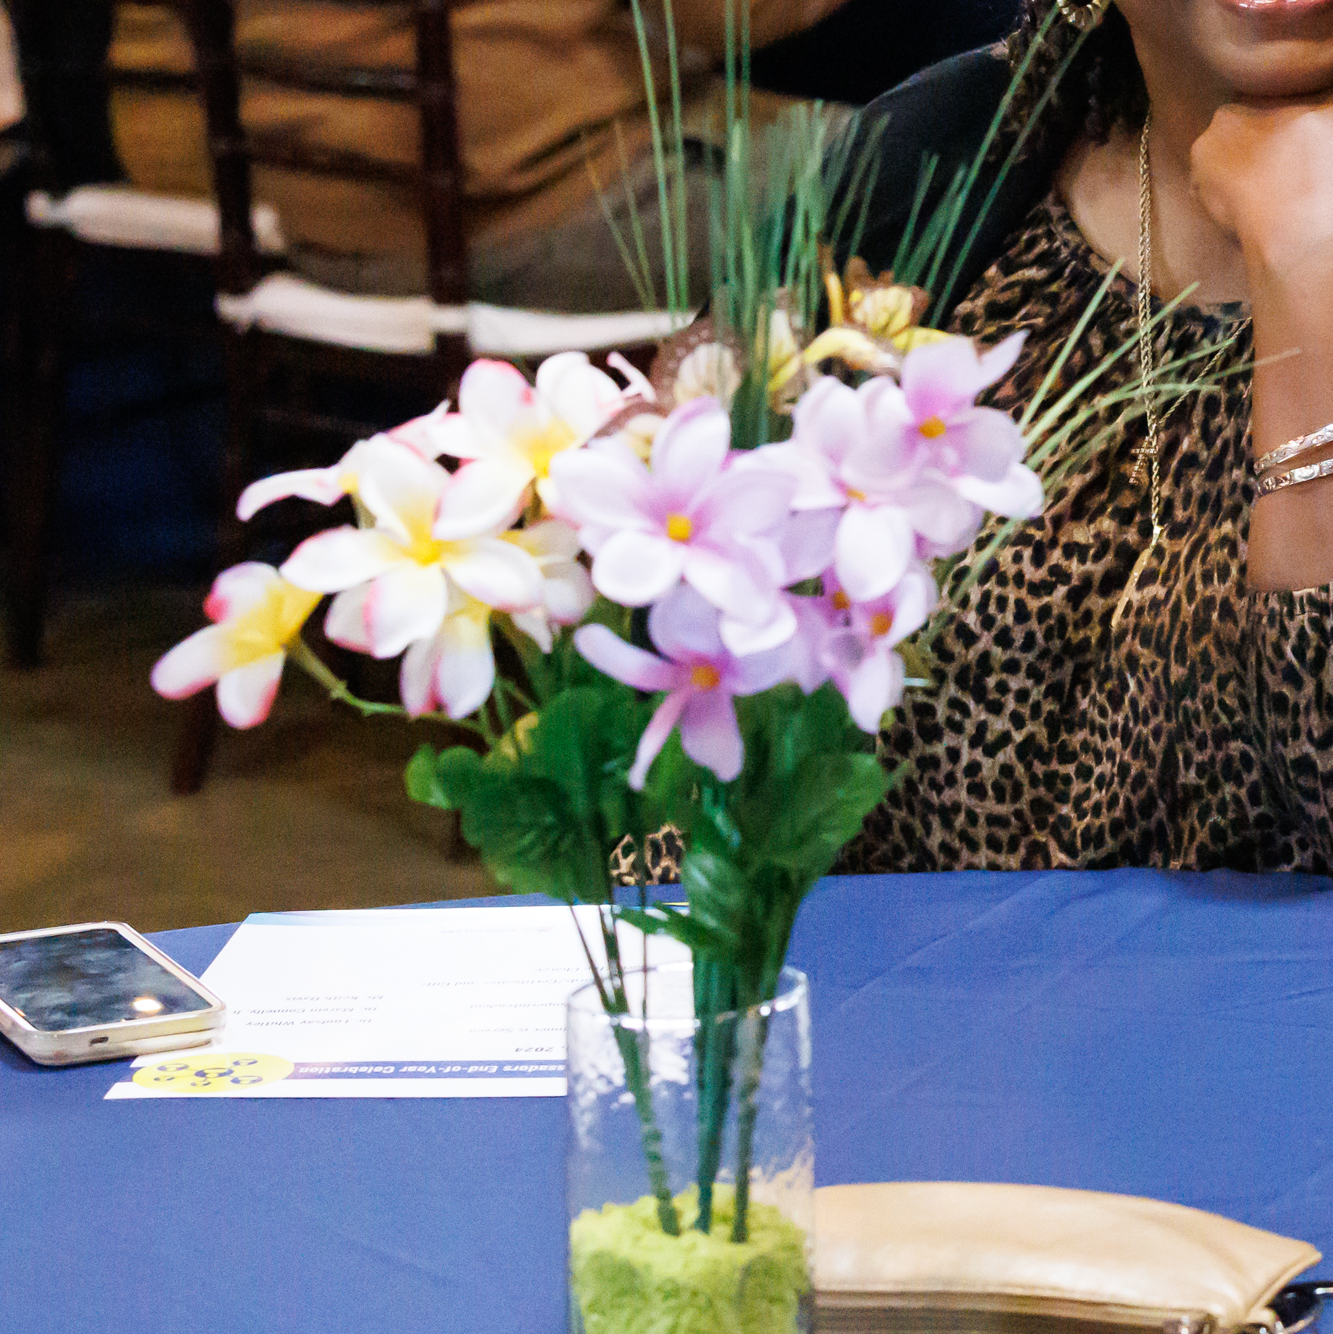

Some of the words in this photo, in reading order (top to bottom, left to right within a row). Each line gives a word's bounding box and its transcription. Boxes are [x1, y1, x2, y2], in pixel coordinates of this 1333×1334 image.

[298, 1065, 396, 1075] Celebration
[400, 1065, 499, 1075] End-of-Year
[502, 1064, 566, 1074] ssadors
